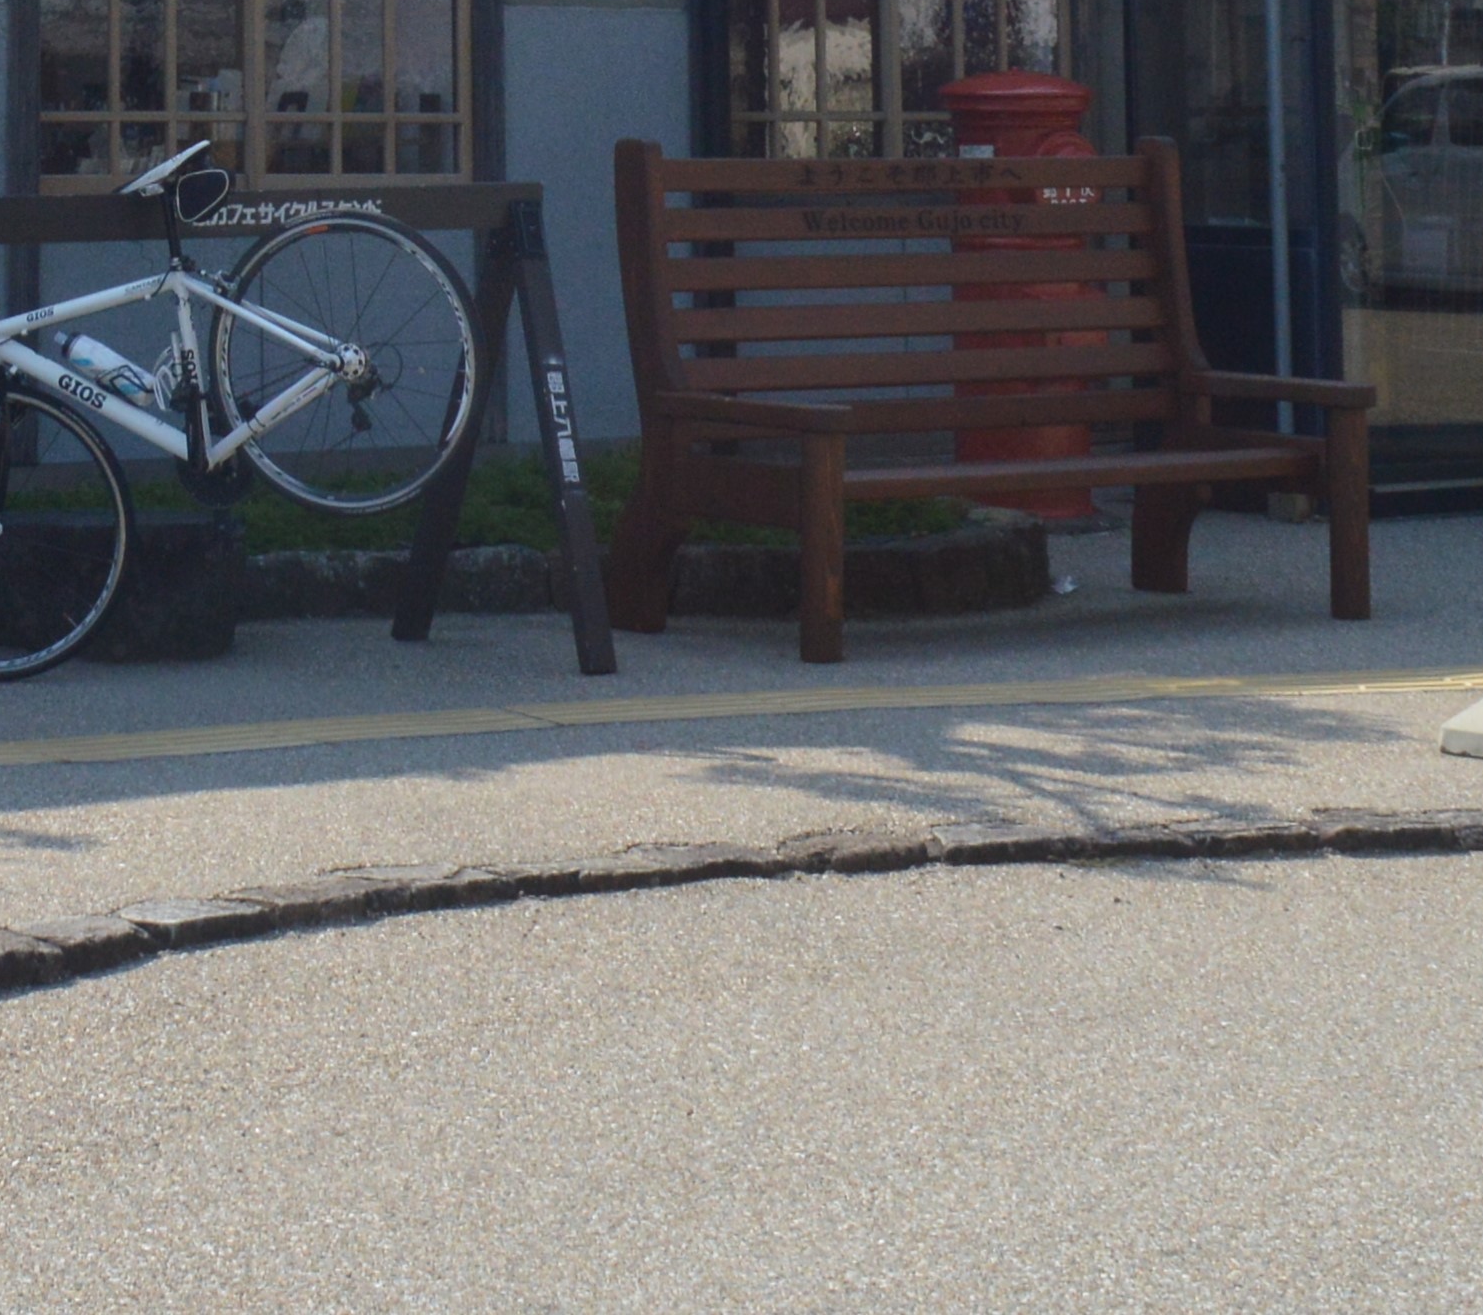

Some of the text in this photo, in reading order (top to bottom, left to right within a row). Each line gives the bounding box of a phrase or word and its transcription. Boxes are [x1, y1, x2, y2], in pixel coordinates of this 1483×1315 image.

[802, 210, 1026, 238] Welcome Gujo city
[26, 306, 55, 323] GIOS
[57, 373, 108, 410] GIOS
